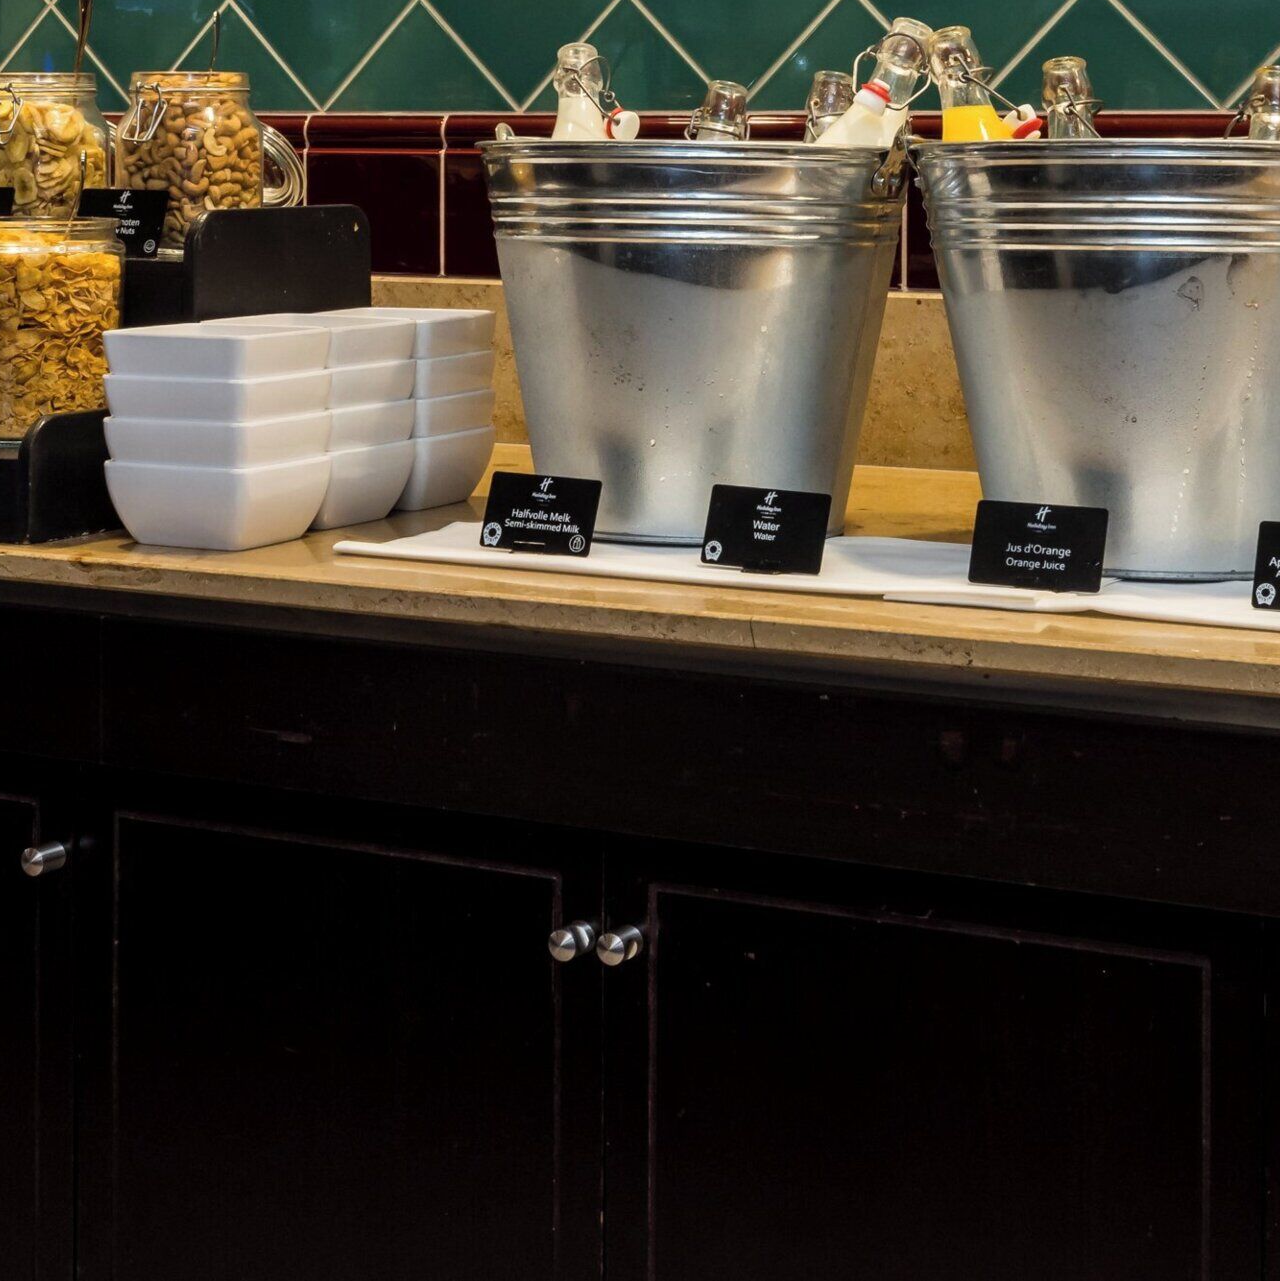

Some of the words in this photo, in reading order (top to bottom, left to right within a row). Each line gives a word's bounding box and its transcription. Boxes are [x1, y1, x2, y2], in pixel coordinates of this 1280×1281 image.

[511, 508, 548, 521] Halfvolle
[550, 512, 571, 522] Melk
[504, 518, 561, 532] Semi-skimmed
[562, 524, 580, 534] Milk
[753, 520, 780, 531] Water
[754, 532, 776, 541] Water
[1006, 543, 1022, 552] Jus
[1024, 543, 1071, 558] d'Orange
[1006, 557, 1040, 570] Orange
[1042, 561, 1065, 570] Juice
